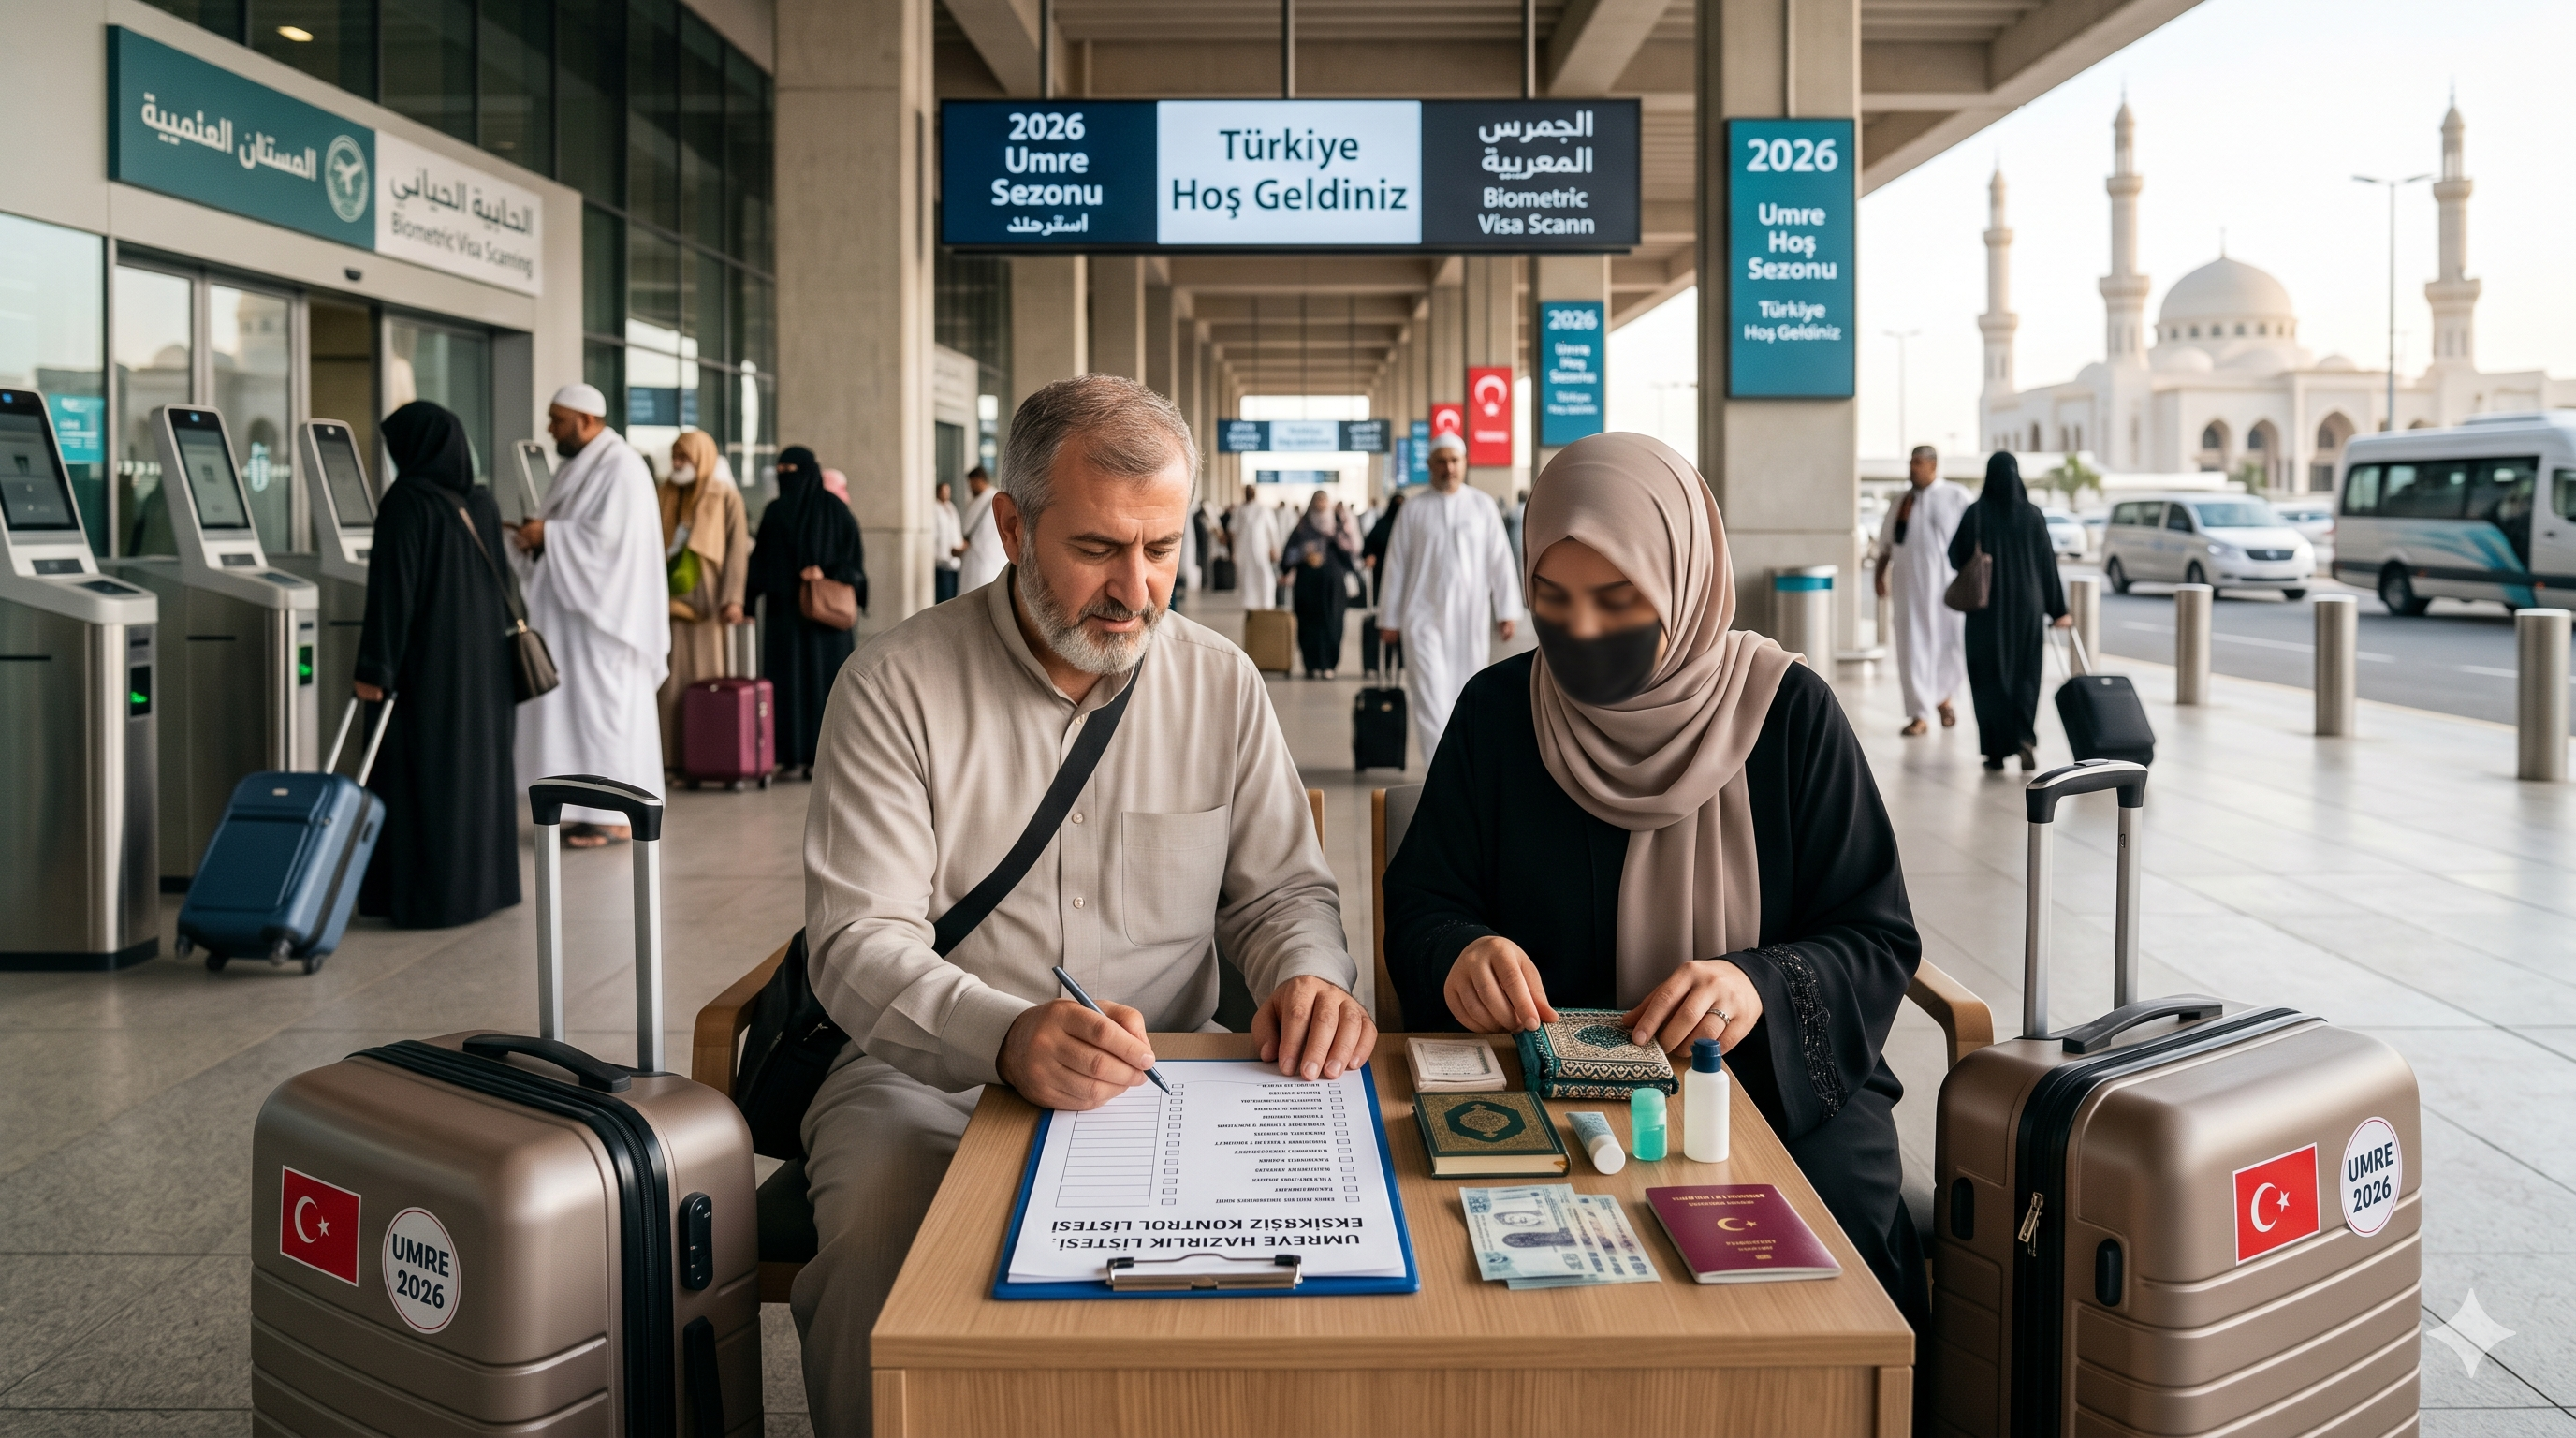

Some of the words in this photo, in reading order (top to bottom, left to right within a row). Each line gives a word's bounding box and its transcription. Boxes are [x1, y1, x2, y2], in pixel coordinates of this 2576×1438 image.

[1008, 112, 1086, 141] 2026
[1005, 146, 1090, 174] Umre
[1220, 128, 1359, 170] Türkiye
[1746, 138, 1839, 172] 2026
[991, 178, 1103, 206] Sezonu
[1173, 179, 1241, 220] Hoş
[1255, 178, 1408, 210] Geldiniz
[1483, 186, 1588, 209] Biometric
[1478, 213, 1524, 235] Visa
[1528, 213, 1595, 235] Scann
[1758, 202, 1826, 227] Umre
[1768, 230, 1817, 259] Hoş
[1748, 257, 1837, 280] Sezonu
[1547, 309, 1599, 330] 2026
[1758, 300, 1826, 324] Türkiye
[1744, 324, 1777, 344] Hoş
[1777, 323, 1841, 341] Geldiniz
[2348, 1141, 2393, 1182] UMRE
[2353, 1174, 2392, 1214] 2026
[1051, 1219, 1132, 1233] LİSTESİ
[1139, 1218, 1243, 1230] KONTROL
[1149, 1236, 1258, 1247] HAZIRLIK
[1263, 1234, 1360, 1245] UMREVE
[392, 1233, 449, 1278] UMRE
[396, 1269, 445, 1310] 2026
